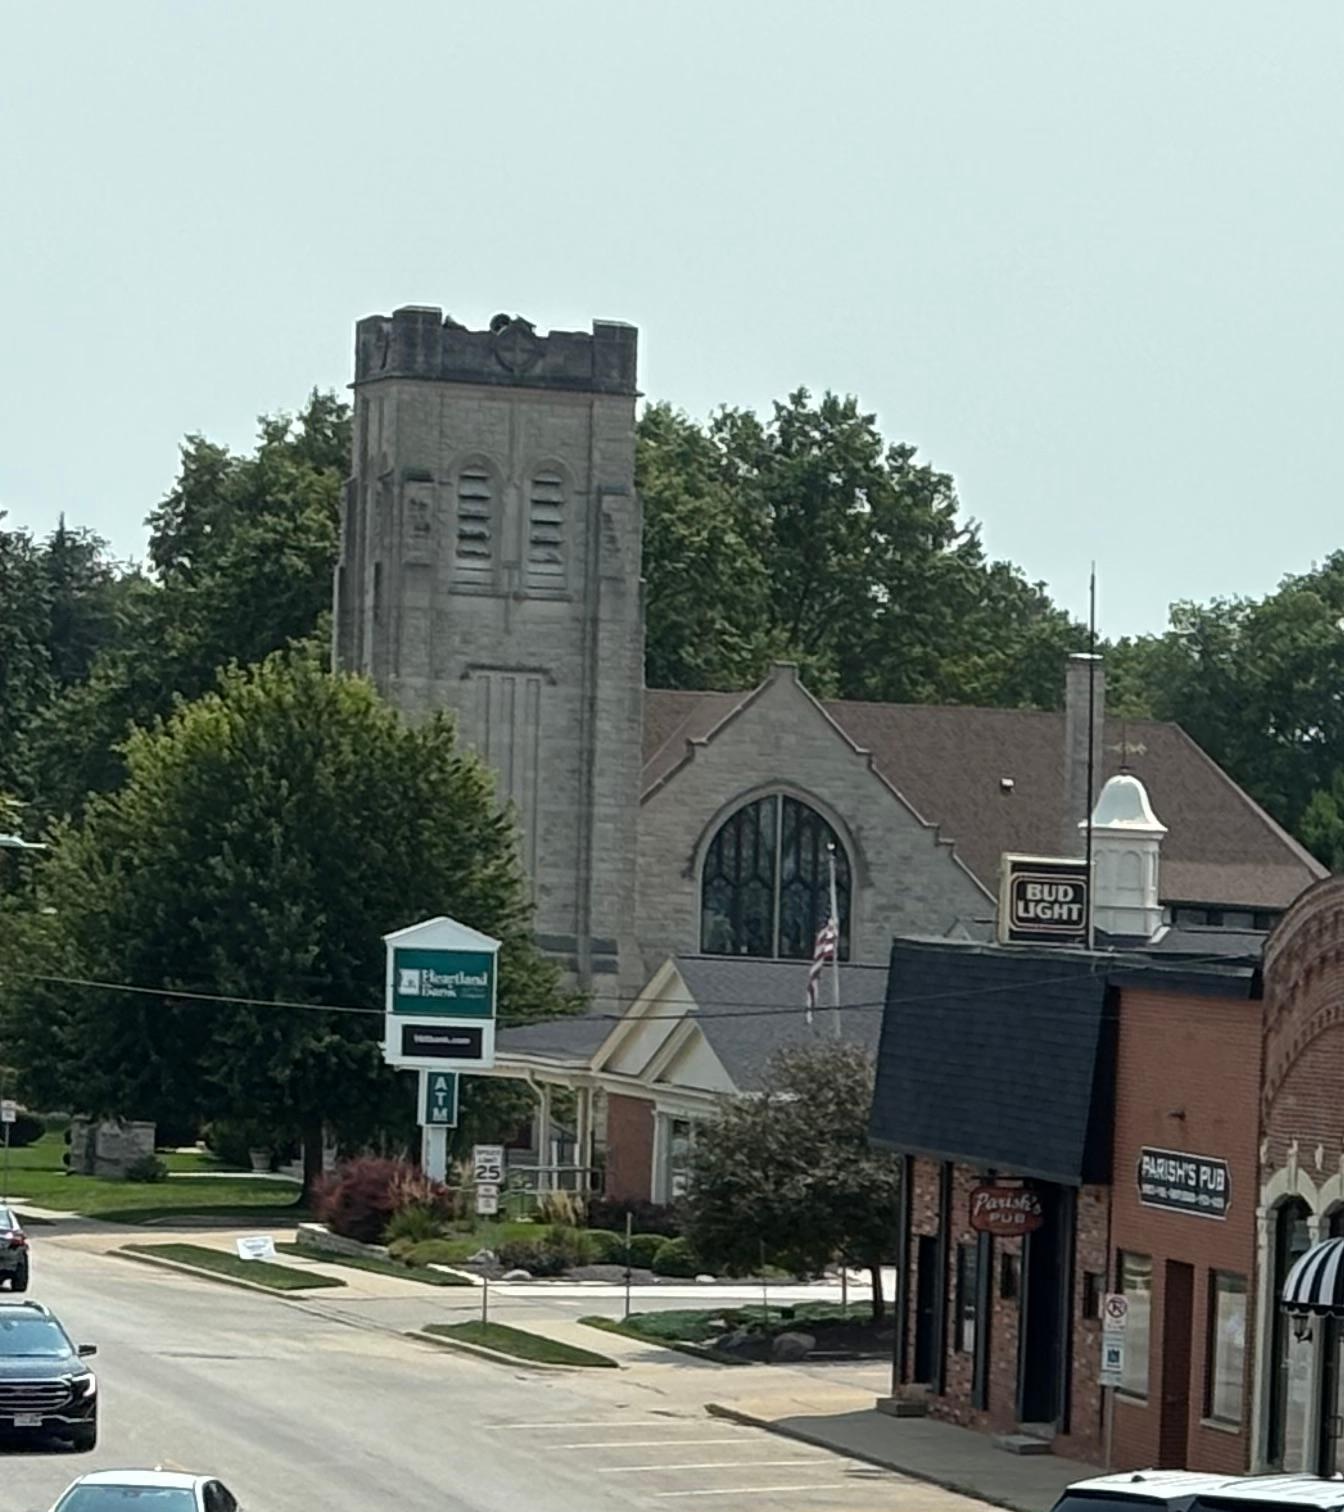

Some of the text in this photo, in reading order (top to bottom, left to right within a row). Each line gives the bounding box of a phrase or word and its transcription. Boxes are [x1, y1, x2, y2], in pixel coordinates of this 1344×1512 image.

[1026, 883, 1074, 902] BUD
[1017, 900, 1082, 921] LIGHT
[422, 968, 488, 987] Heartland
[432, 1075, 449, 1122] ATM
[476, 1165, 500, 1180] 25
[1141, 1155, 1226, 1191] PARISH'S PUB
[990, 1211, 1026, 1224] PUB
